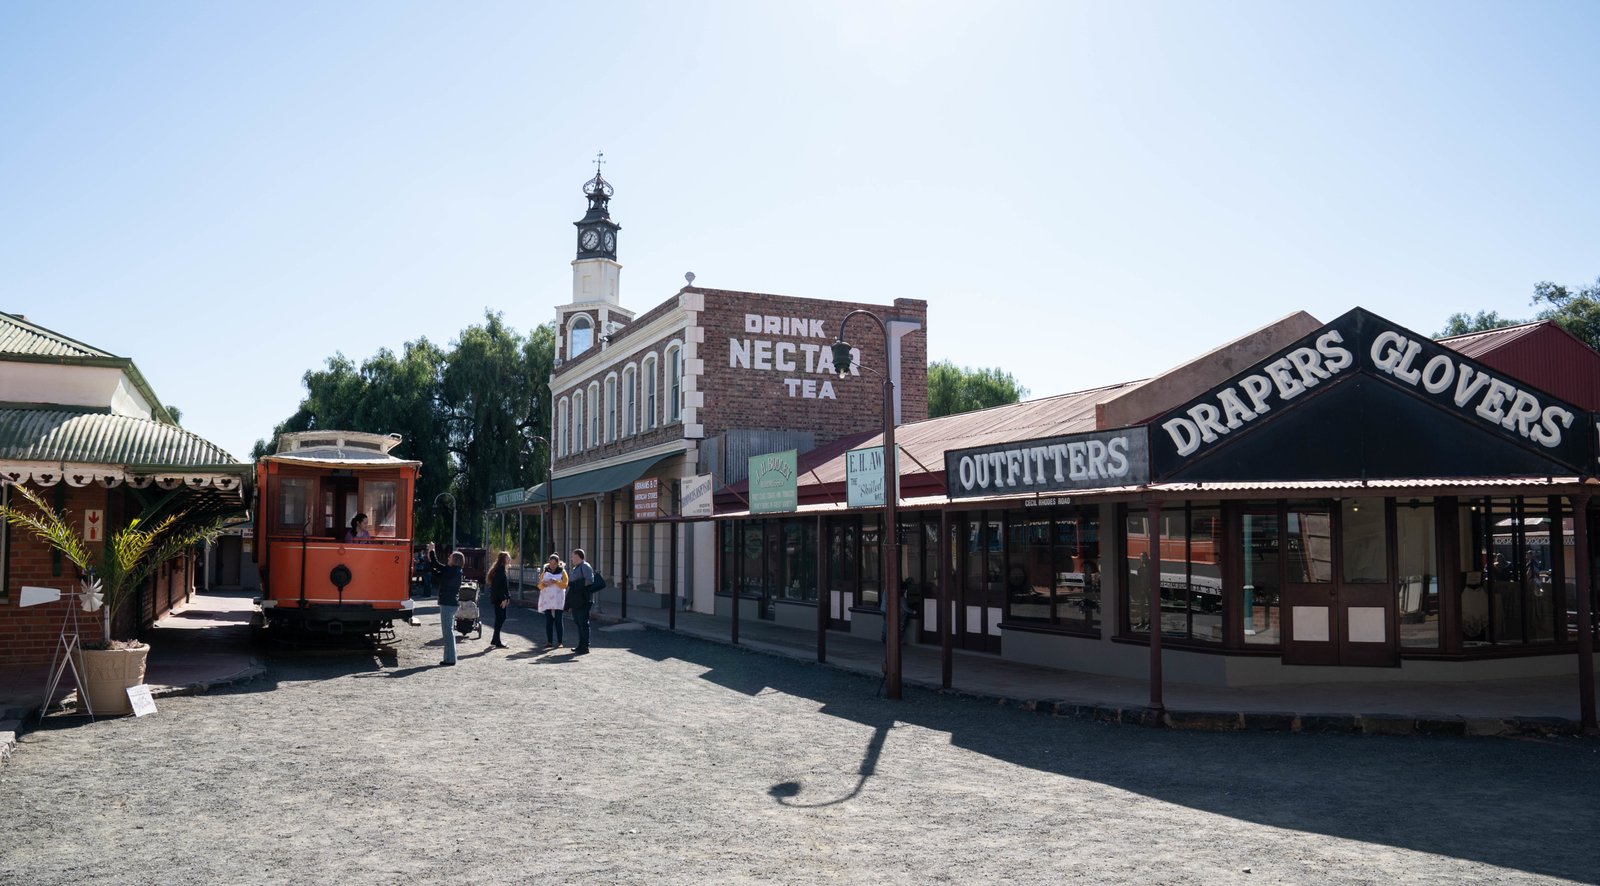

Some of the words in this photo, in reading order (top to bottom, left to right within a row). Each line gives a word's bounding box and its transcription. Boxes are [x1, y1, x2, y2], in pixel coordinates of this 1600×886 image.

[745, 313, 826, 339] DRINK
[729, 337, 861, 377] NECTAR
[784, 378, 837, 400] TEA
[1161, 329, 1353, 457] DRAPERS
[1370, 330, 1575, 448] GLOVERS
[849, 454, 858, 473] E.
[859, 453, 868, 472] H.
[868, 450, 883, 471] AW
[959, 436, 1130, 491] OUTFITTERS
[1039, 498, 1056, 506] RHODES
[1058, 497, 1070, 505] ROAD
[394, 555, 400, 565] 2
